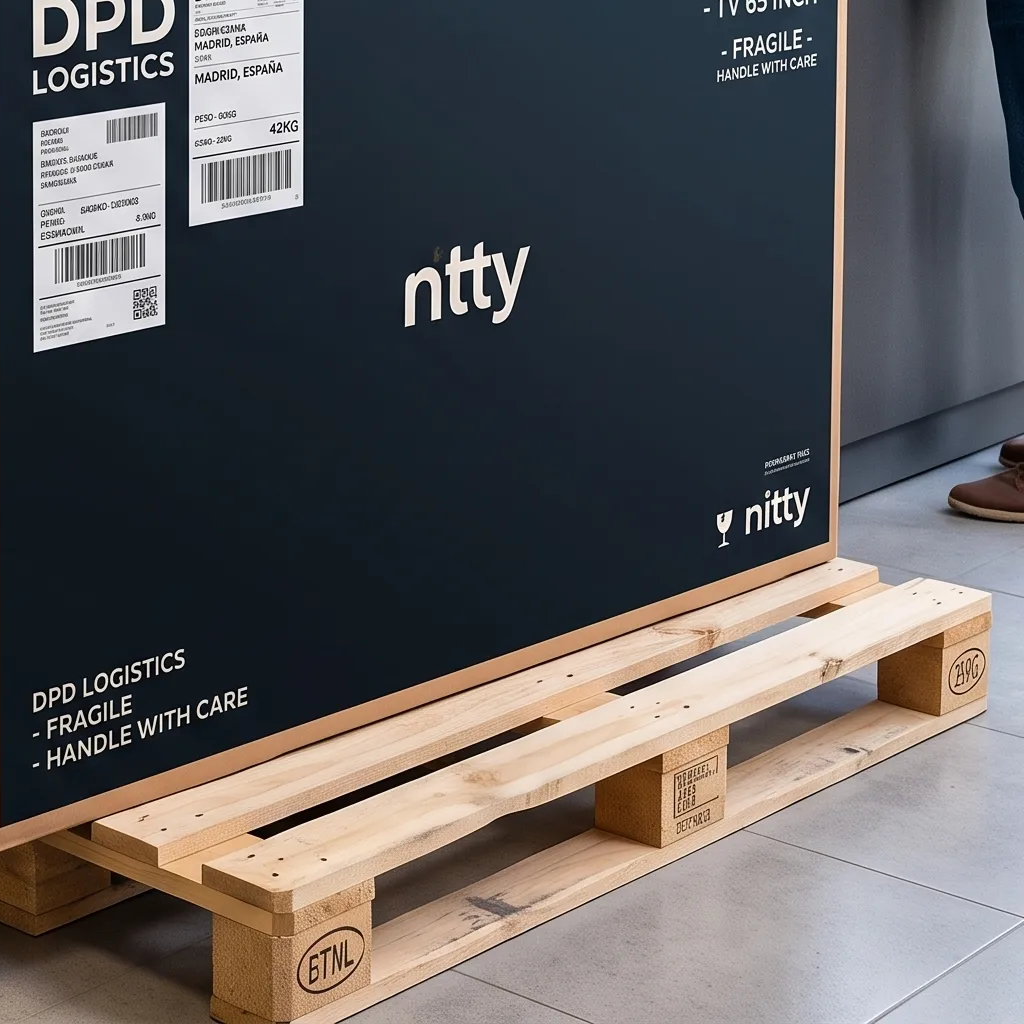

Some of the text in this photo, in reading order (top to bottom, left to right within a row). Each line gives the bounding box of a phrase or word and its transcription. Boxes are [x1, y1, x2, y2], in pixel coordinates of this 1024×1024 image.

[194, 38, 233, 51] MADRID,
[732, 28, 803, 60] FRAGILE
[32, 51, 175, 95] LOGISTICS
[194, 60, 283, 85] MADRID, ESPAÑA
[716, 53, 818, 83] HANDLE WITH CARE
[269, 119, 299, 135] 42KG
[745, 486, 811, 536] nitty
[32, 648, 186, 714] DPD LOGISTICS
[46, 694, 133, 740] FRAGILE
[46, 724, 132, 771] HANDLE
[137, 704, 191, 740] WITH
[196, 686, 249, 720] CARE
